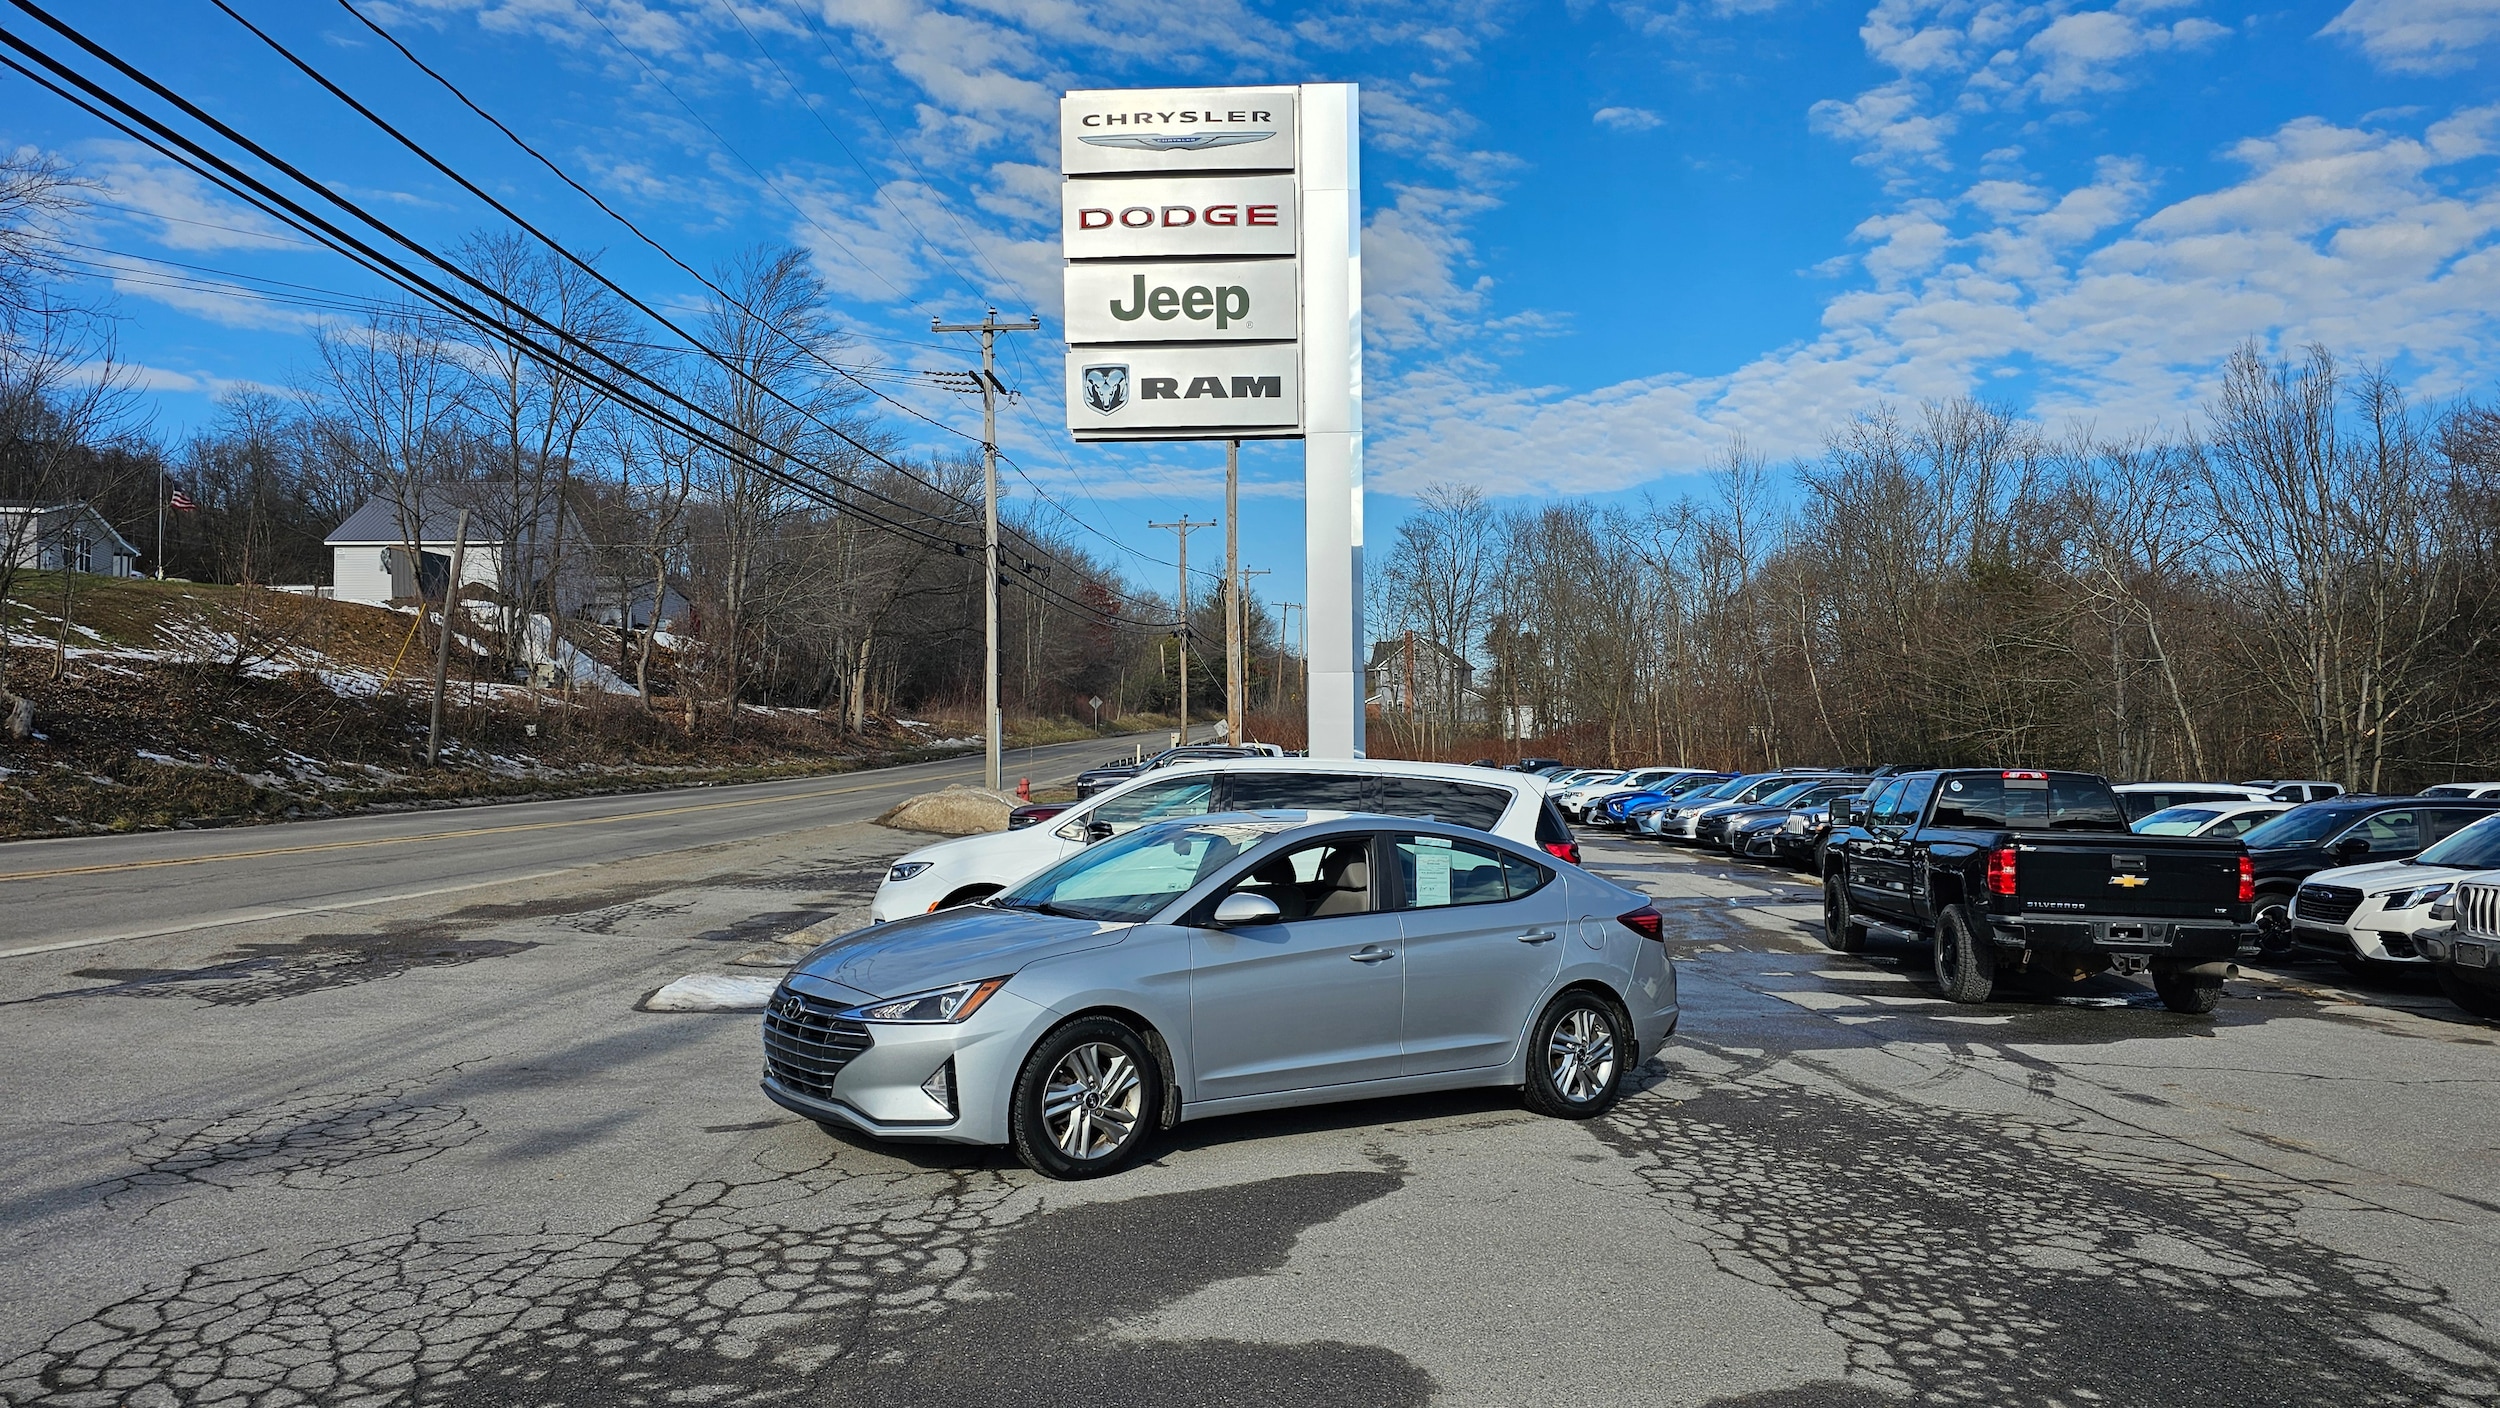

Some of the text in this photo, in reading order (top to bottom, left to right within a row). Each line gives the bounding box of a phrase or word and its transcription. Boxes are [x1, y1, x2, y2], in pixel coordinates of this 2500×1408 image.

[1082, 110, 1272, 127] CHRYSLER
[1079, 204, 1279, 231] DODGE
[1109, 274, 1251, 330] Jeep
[1140, 375, 1282, 400] RAM
[2026, 901, 2086, 910] SILVERADO
